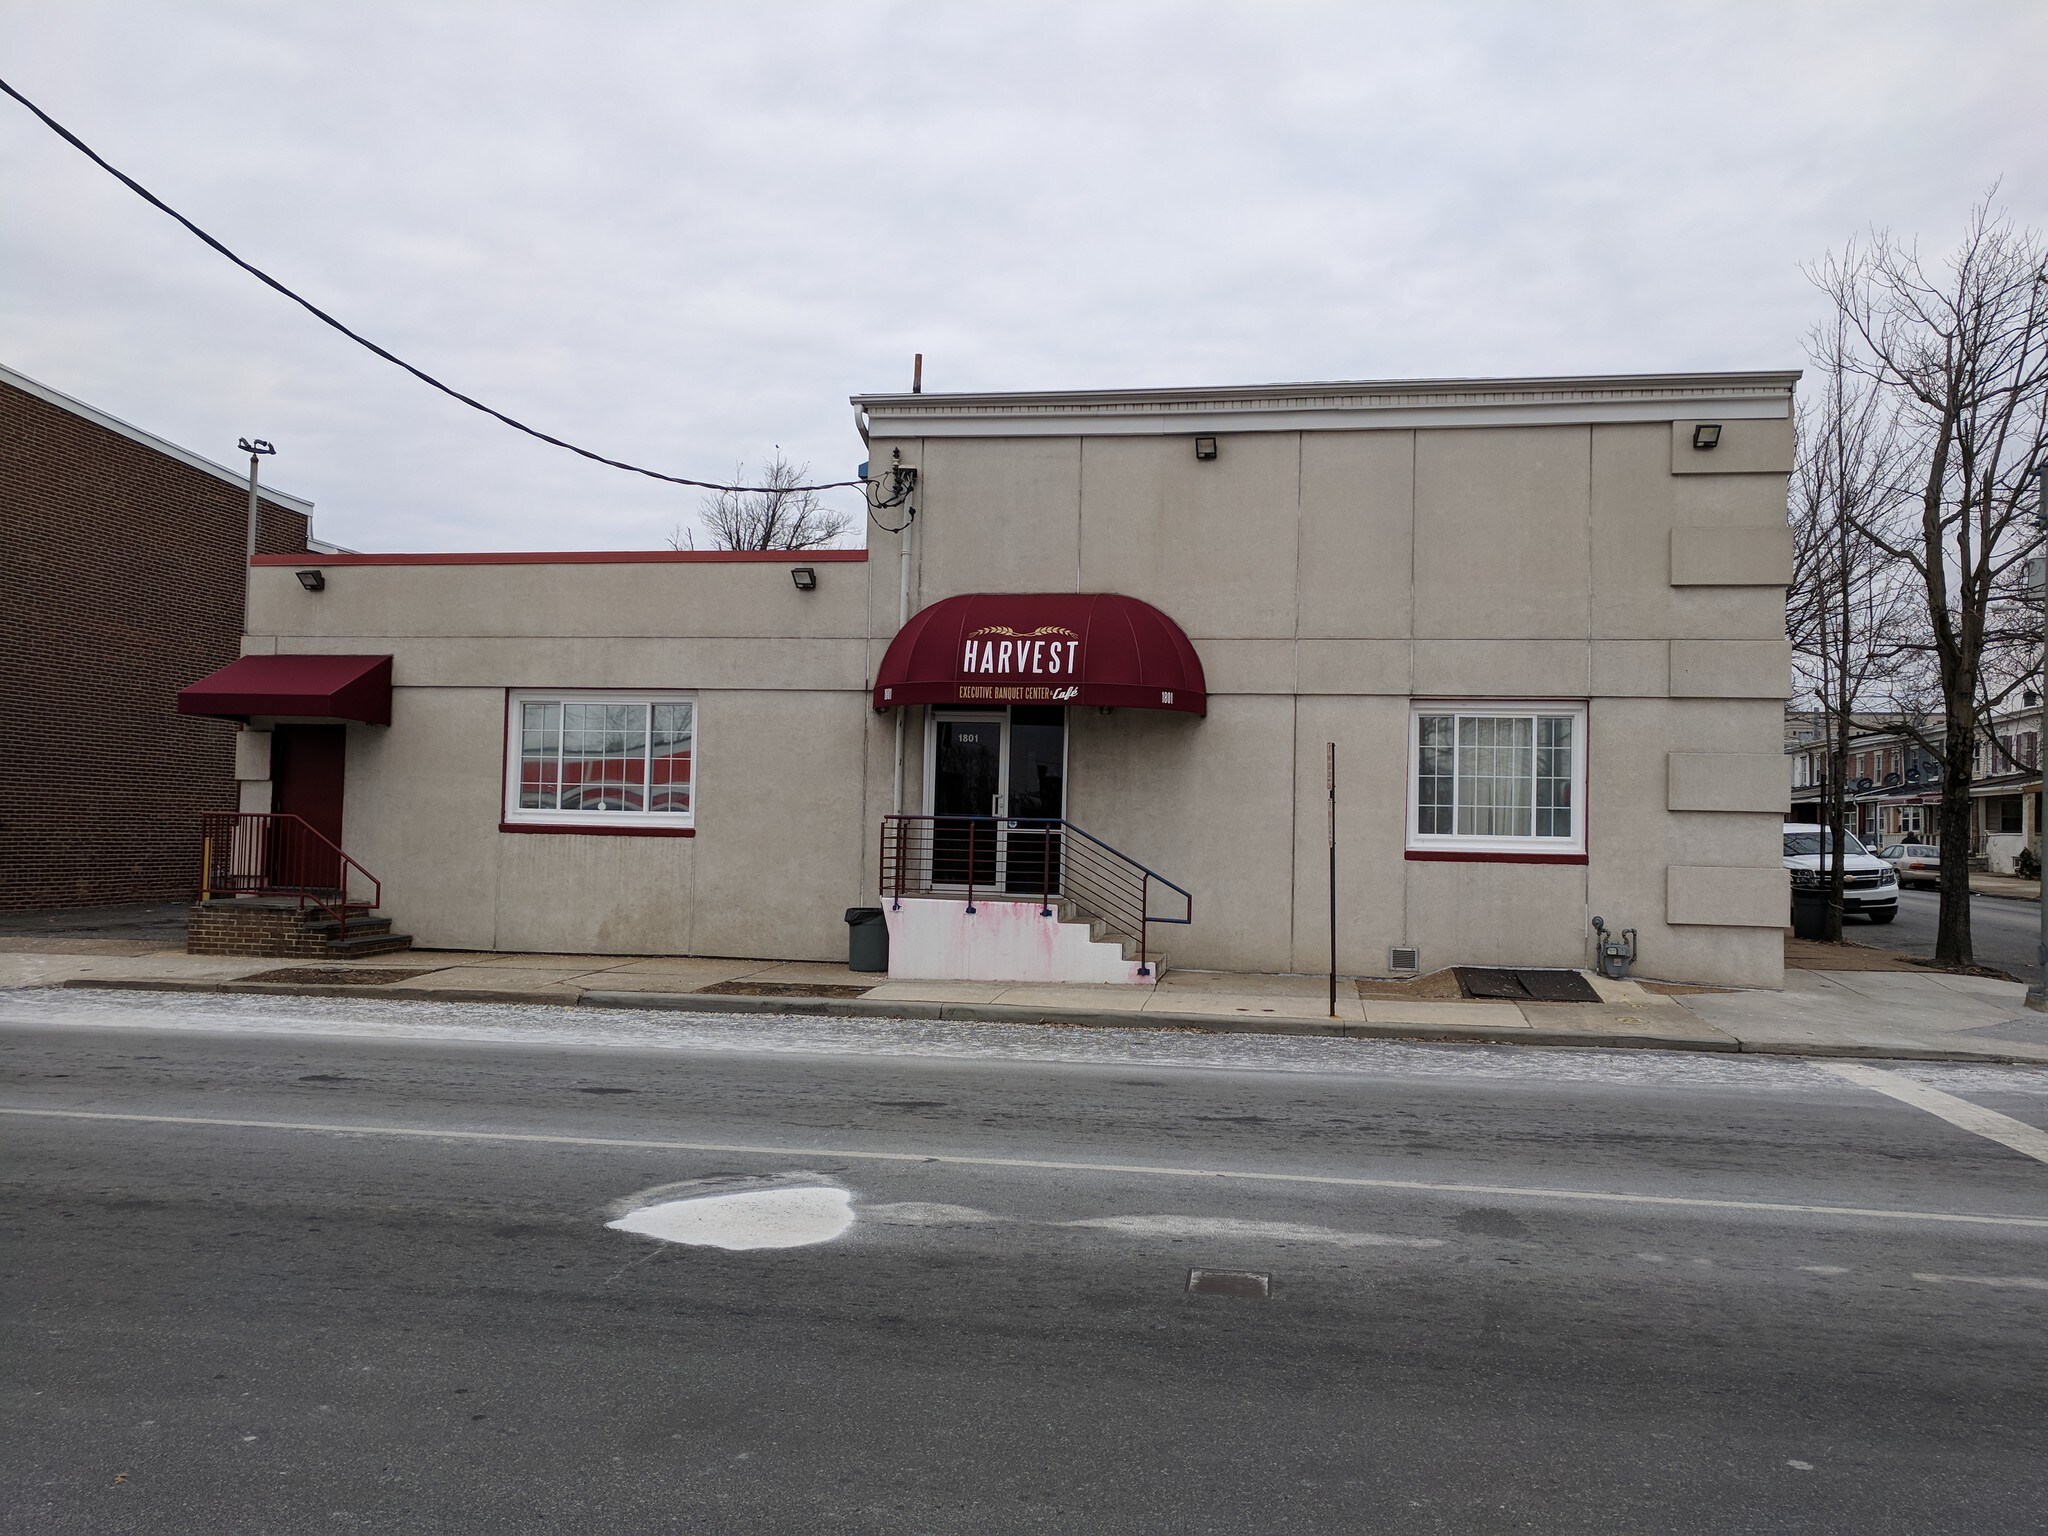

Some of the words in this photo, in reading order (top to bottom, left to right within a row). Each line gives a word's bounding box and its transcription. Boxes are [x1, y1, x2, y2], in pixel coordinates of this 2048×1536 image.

[963, 640, 1079, 674] HARVEST
[959, 686, 993, 699] EXECUTIVE
[994, 687, 1024, 700] BANQUET
[1025, 687, 1050, 700] CENTER
[1052, 686, 1079, 700] Café
[1161, 691, 1174, 704] 1801
[958, 733, 979, 743] 1801
